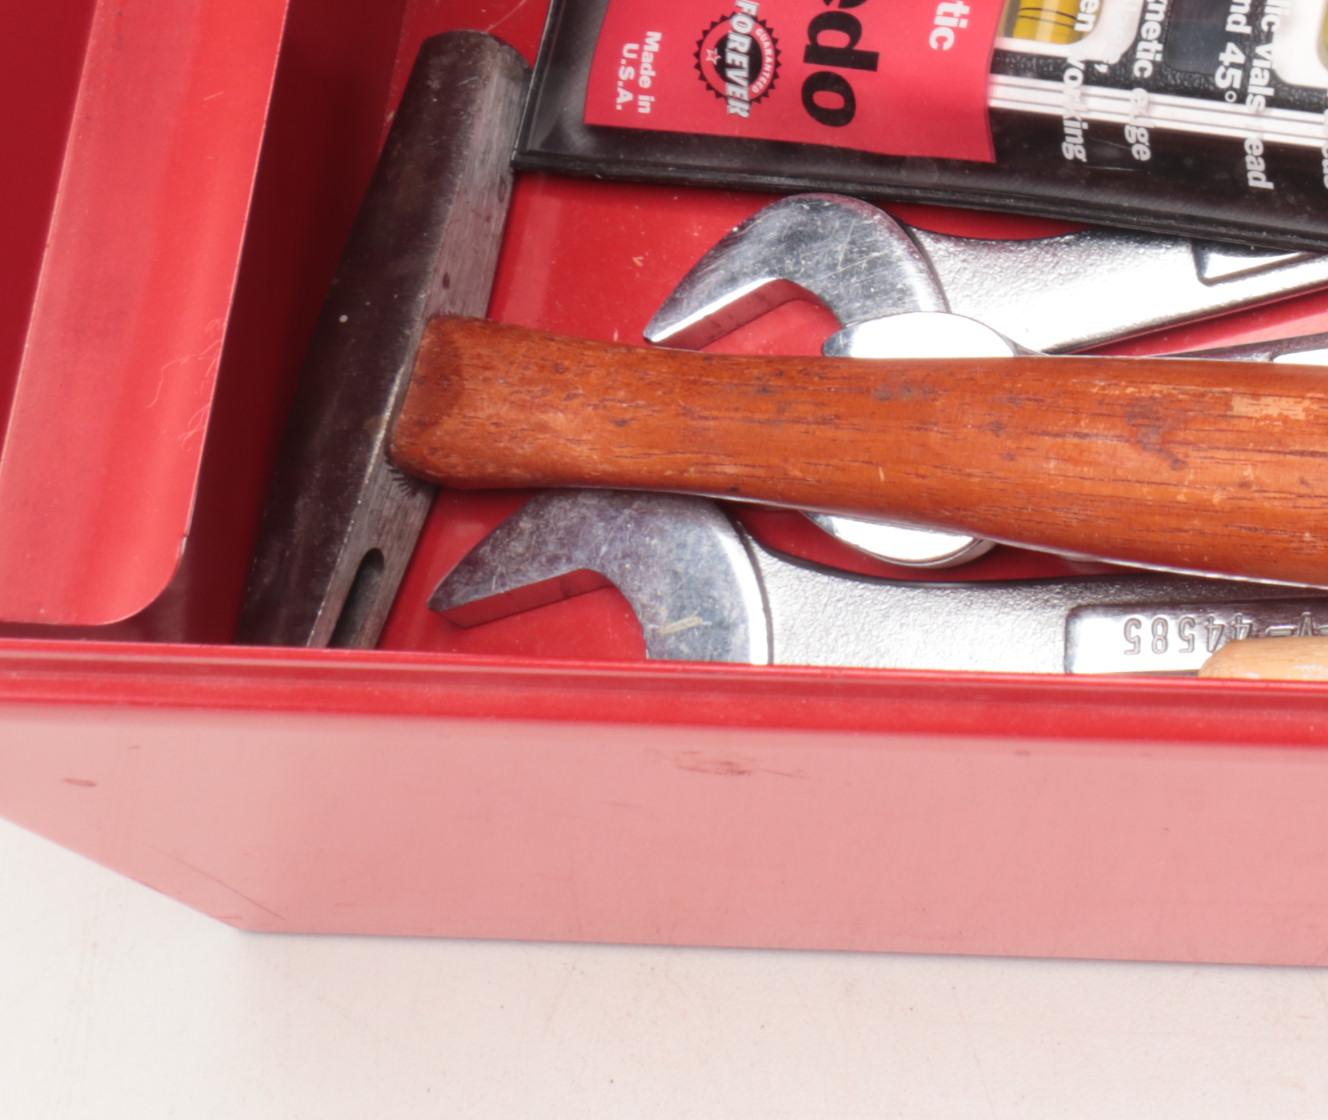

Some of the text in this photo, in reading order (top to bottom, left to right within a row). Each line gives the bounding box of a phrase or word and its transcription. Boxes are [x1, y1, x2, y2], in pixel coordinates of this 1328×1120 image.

[615, 43, 640, 111] U.S.A.
[637, 31, 662, 114] Made in
[751, 28, 773, 93] GUARANTEED
[1215, 42, 1245, 103] 45°
[1246, 41, 1274, 113] vials
[1244, 119, 1274, 190] ead
